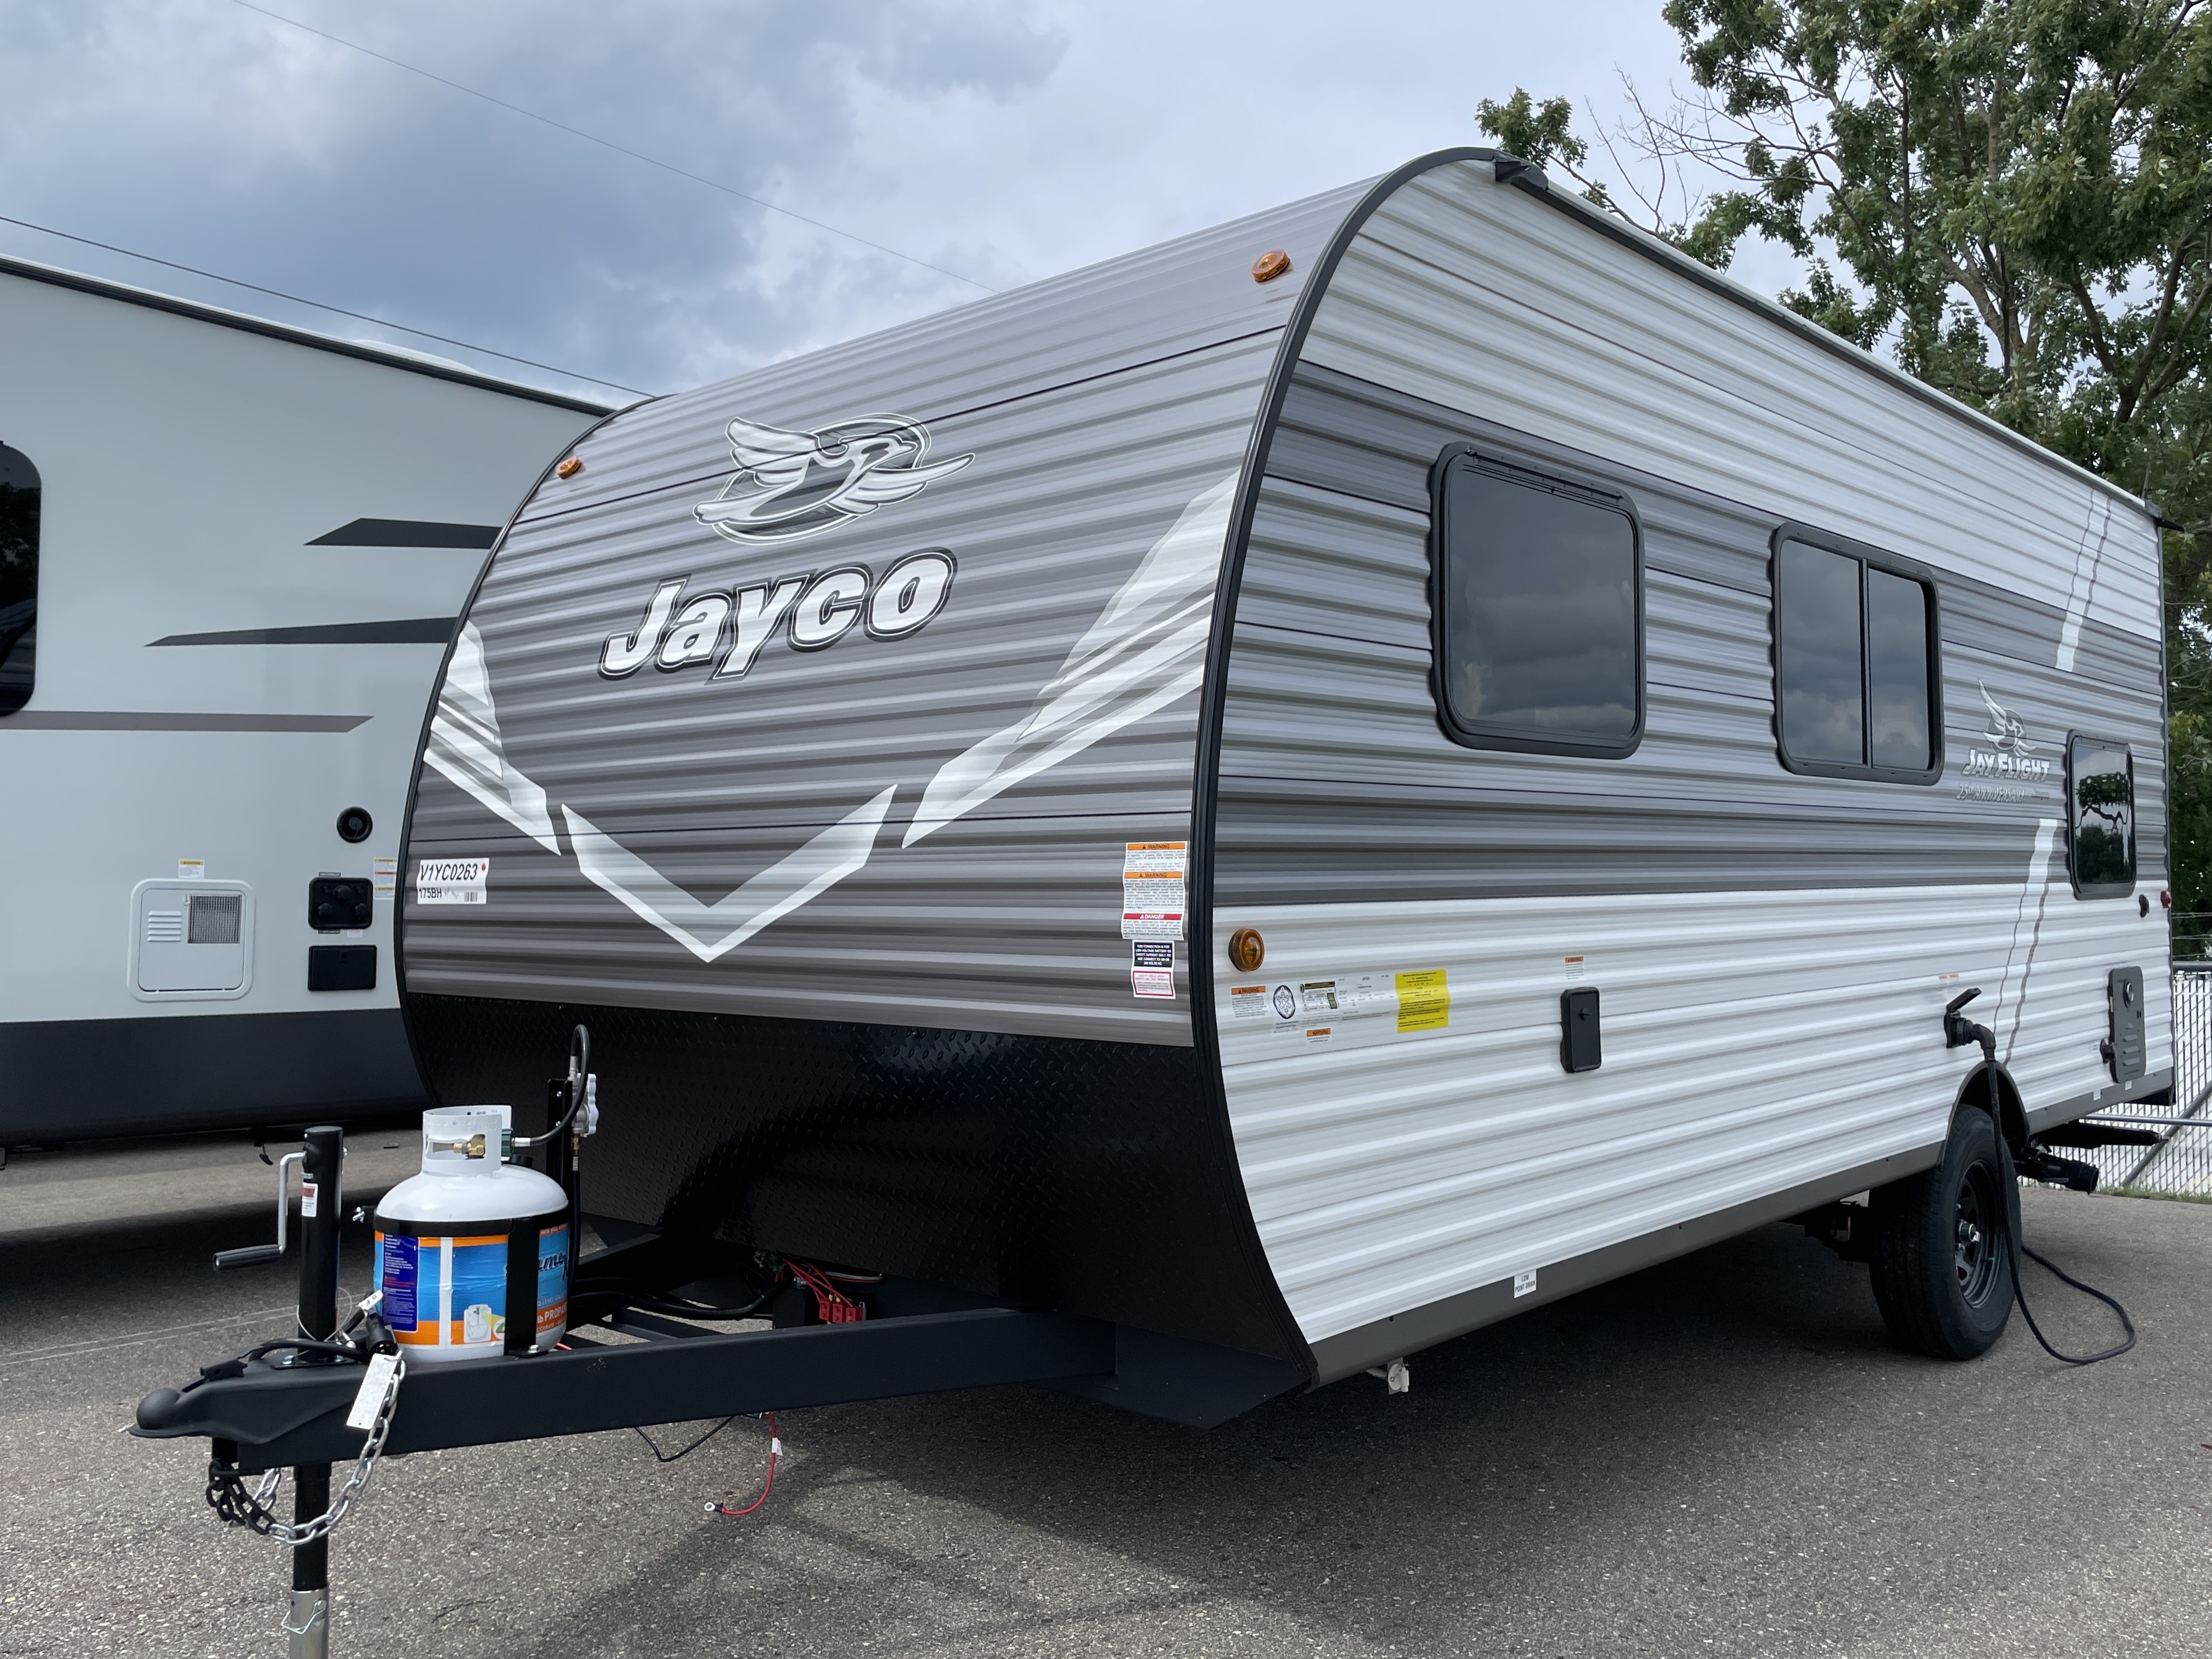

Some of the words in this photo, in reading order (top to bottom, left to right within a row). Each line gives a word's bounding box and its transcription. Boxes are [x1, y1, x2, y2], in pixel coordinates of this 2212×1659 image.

[598, 549, 956, 684] Jayco
[1962, 748, 1996, 776] JAY
[1995, 753, 2050, 782] FLIGHT
[1972, 785, 2025, 804] ANNIVERSARY
[420, 863, 478, 882] V1YC0263
[419, 887, 442, 898] 175BH
